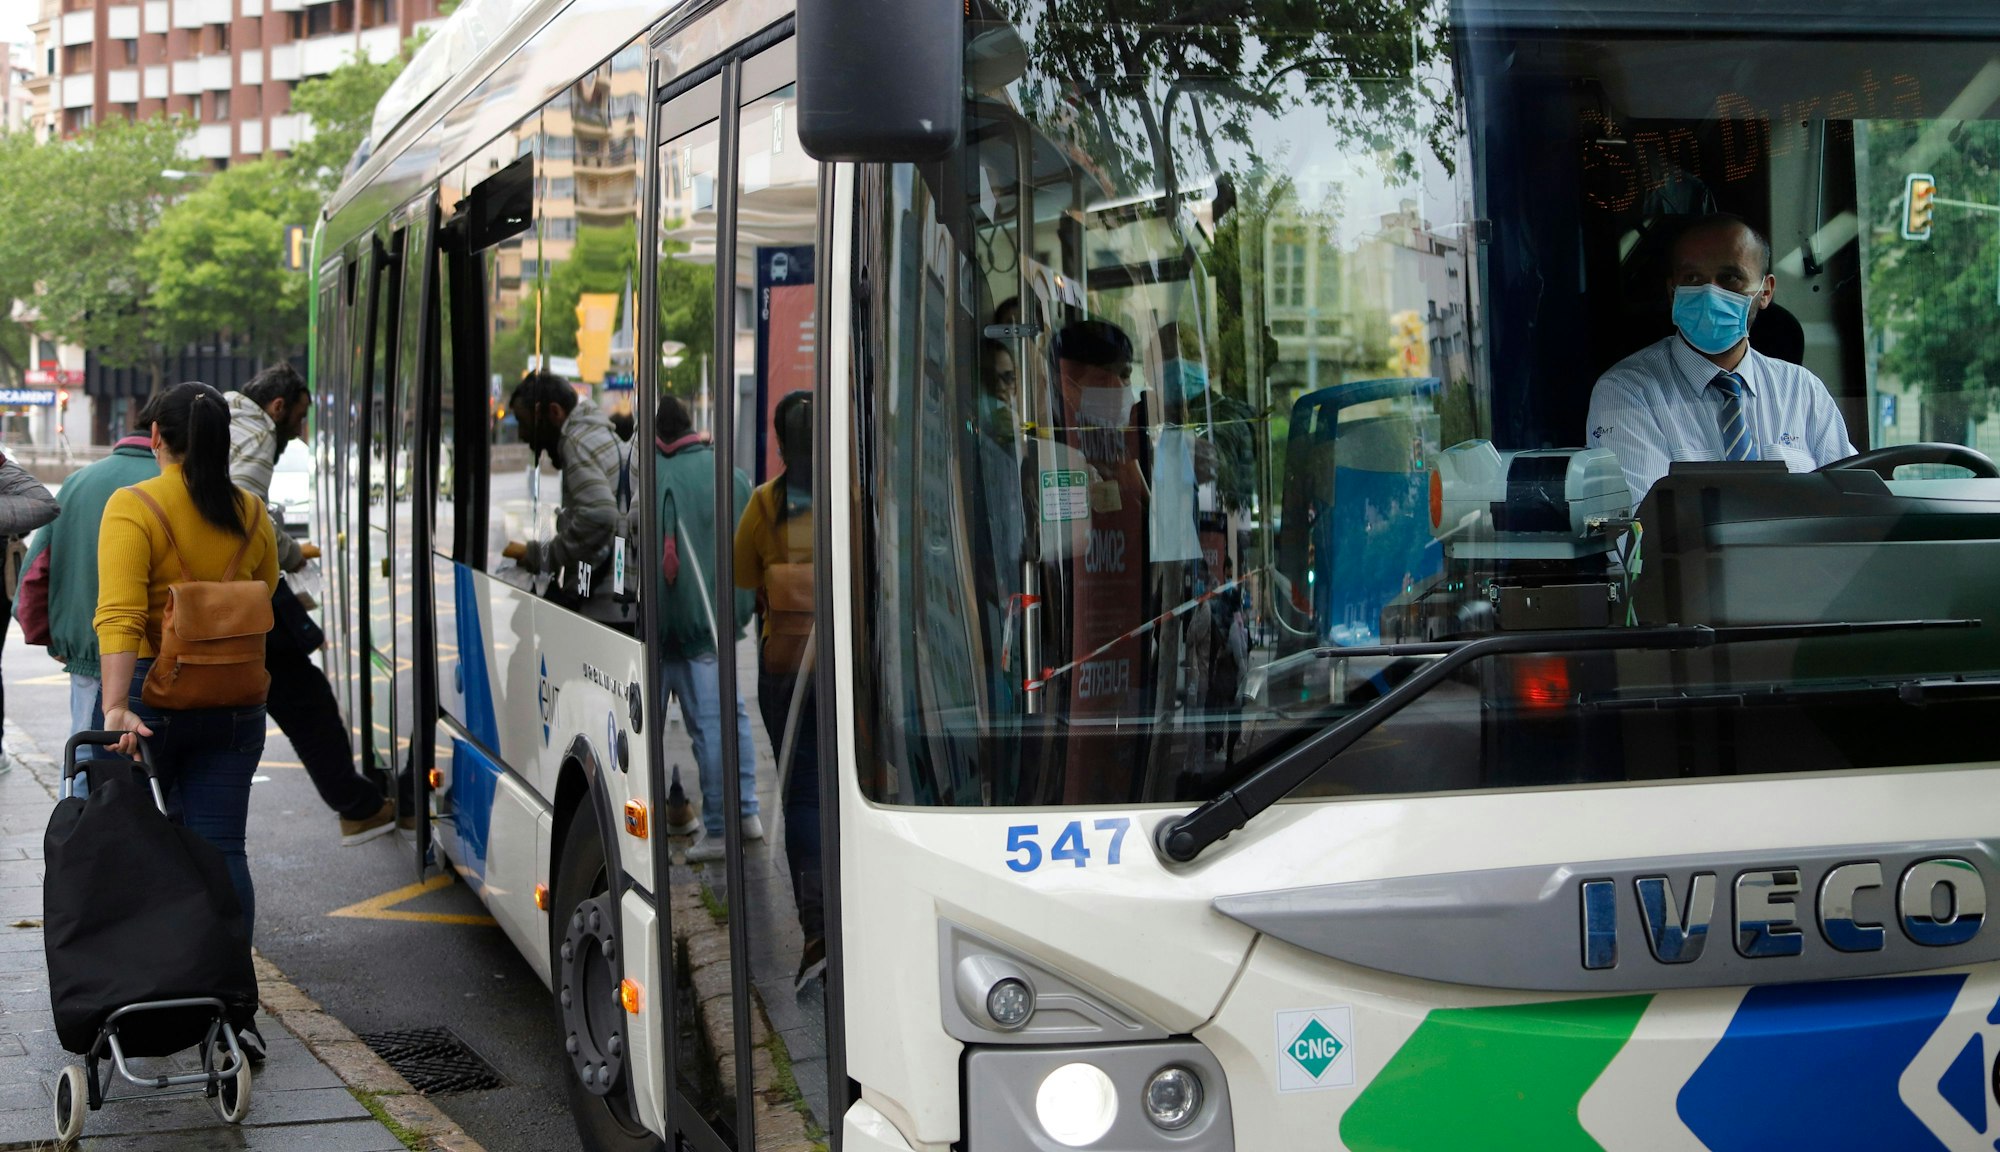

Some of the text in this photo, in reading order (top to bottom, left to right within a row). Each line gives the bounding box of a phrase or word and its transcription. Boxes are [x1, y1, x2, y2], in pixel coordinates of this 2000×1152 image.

[1578, 68, 1923, 213] Son Dureta
[577, 560, 592, 598] 547
[1005, 817, 1131, 873] 547
[1581, 857, 1988, 970] IVECO
[1295, 1037, 1336, 1060] CNG
